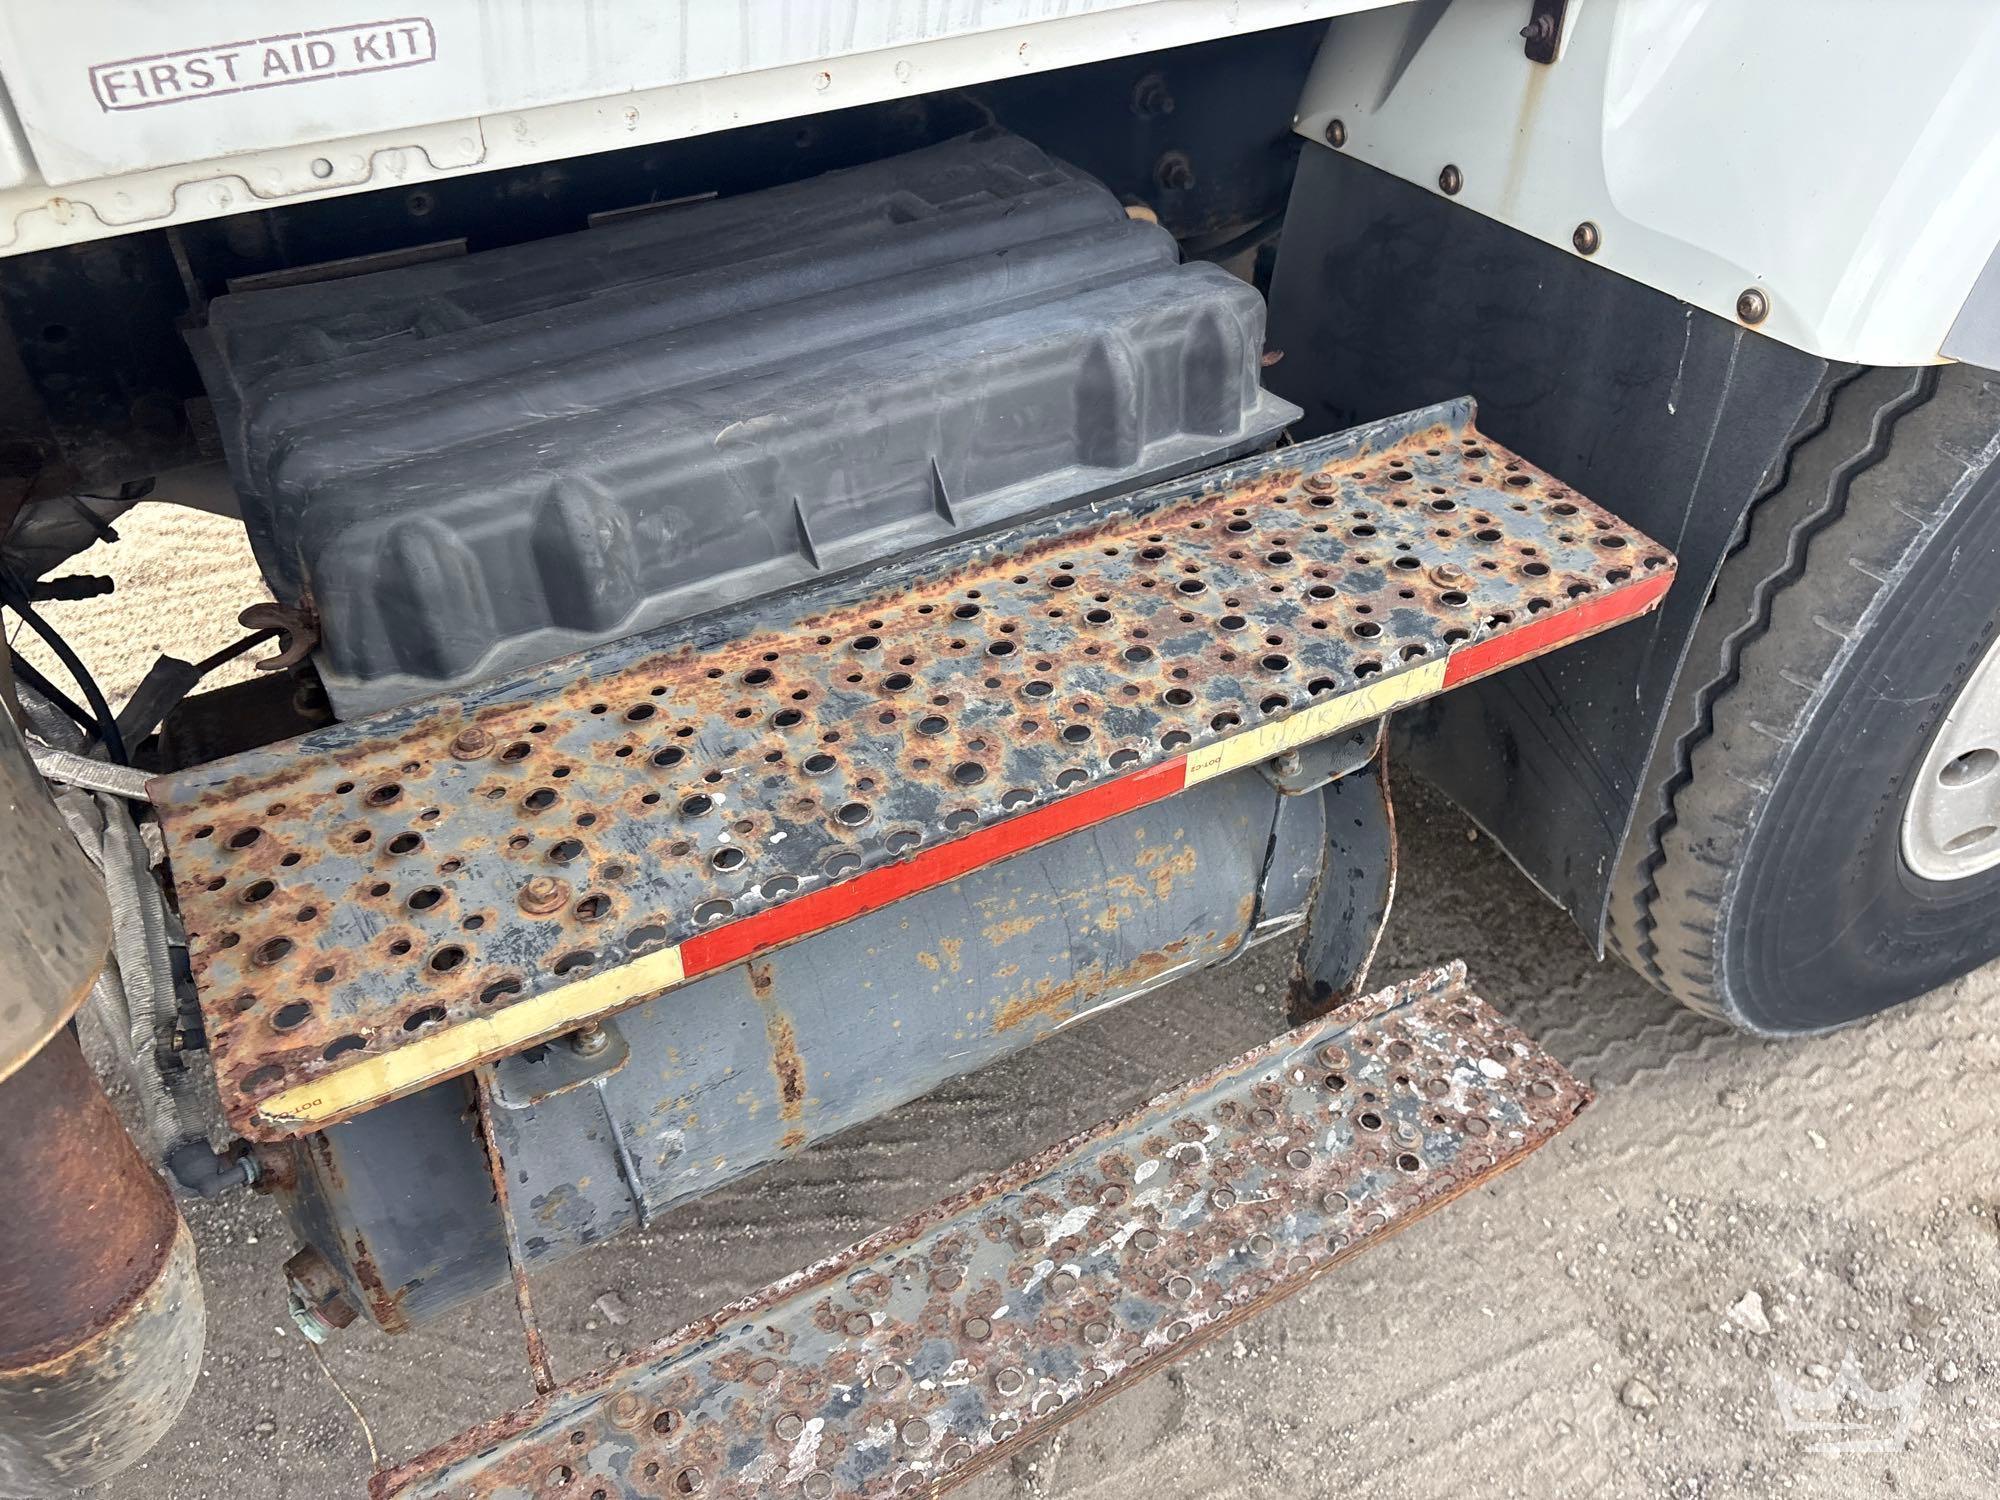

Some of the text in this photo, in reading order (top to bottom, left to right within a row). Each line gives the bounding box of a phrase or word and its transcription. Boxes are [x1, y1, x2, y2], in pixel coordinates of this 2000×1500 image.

[102, 27, 419, 103] FIRST AID KIT
